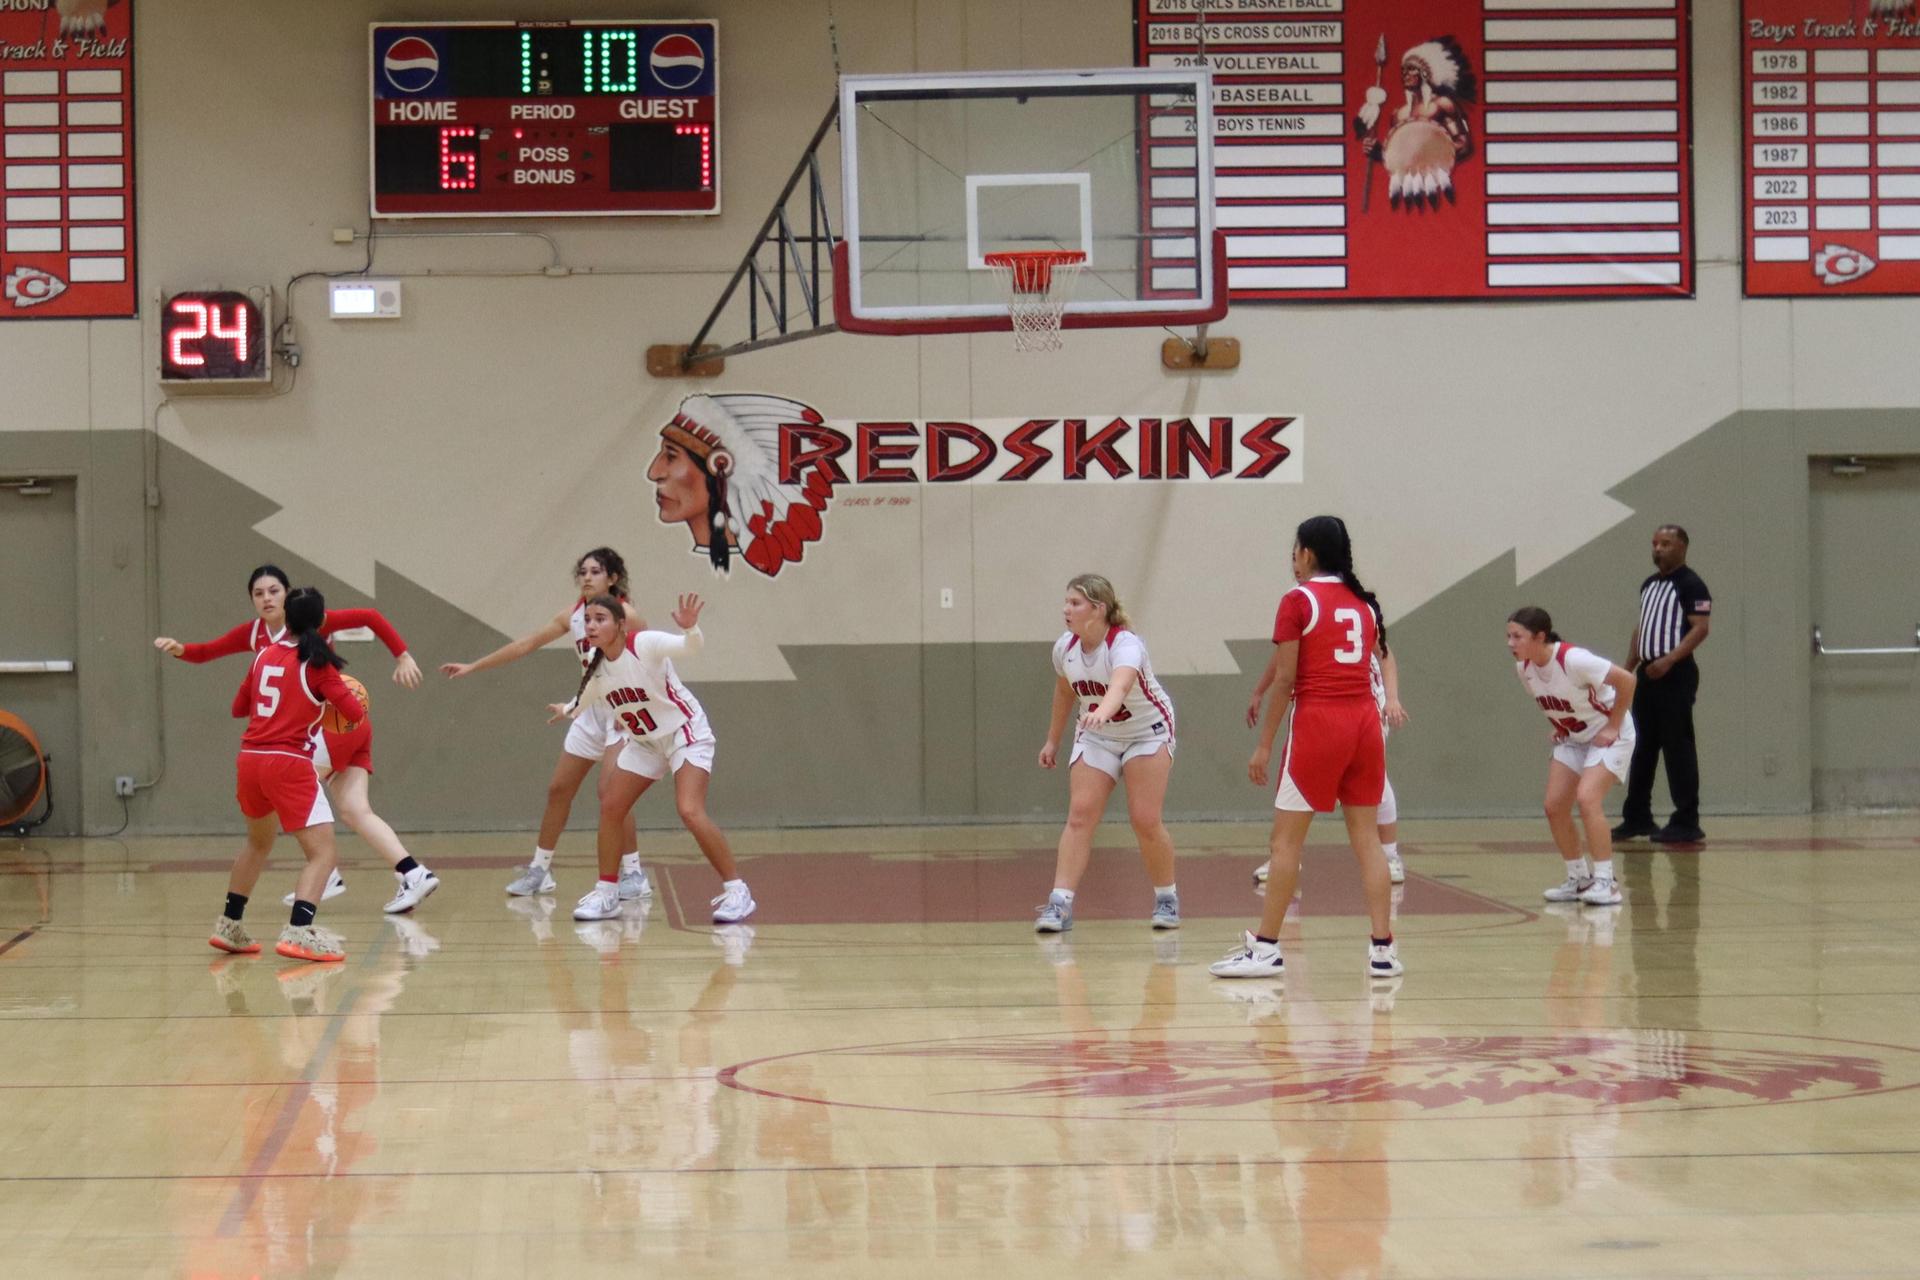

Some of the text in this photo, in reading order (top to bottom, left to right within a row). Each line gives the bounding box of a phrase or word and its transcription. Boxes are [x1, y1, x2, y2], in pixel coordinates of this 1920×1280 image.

[1191, 0, 1234, 9] GIRLS
[1238, 0, 1333, 9] BASKETBALL
[1151, 24, 1337, 40] 2018 BOYS CROSS COUNTRY
[1748, 19, 1795, 42] Boys
[1803, 18, 1857, 37] Track
[1863, 18, 1878, 37] &
[52, 40, 69, 58] &
[74, 38, 128, 58] Field
[520, 31, 637, 93] 1:10
[1213, 57, 1320, 70] VOLLEYBALL
[1760, 55, 1798, 69] 1978
[1221, 88, 1314, 102] BASEBALL
[1760, 85, 1798, 100] 1982
[389, 101, 458, 121] HOME
[510, 104, 576, 120] PERIOD
[619, 99, 699, 119] GUEST
[1217, 118, 1255, 131] BOYS
[1258, 117, 1306, 131] TENNIS
[1761, 117, 1799, 131] 1986
[440, 127, 476, 189] 6
[518, 147, 570, 163] POSS
[675, 126, 710, 187] 7
[1762, 148, 1798, 162] 1987
[513, 168, 576, 184] BONUS
[1765, 180, 1797, 194] 2022
[1765, 211, 1797, 225] 2023
[171, 300, 247, 366] 24
[778, 416, 1298, 485] REDSKINS
[1334, 608, 1363, 663] 3
[257, 665, 285, 717] 5
[1072, 680, 1108, 697] TRIB
[605, 687, 650, 709] TRIBE
[621, 708, 658, 735] 21
